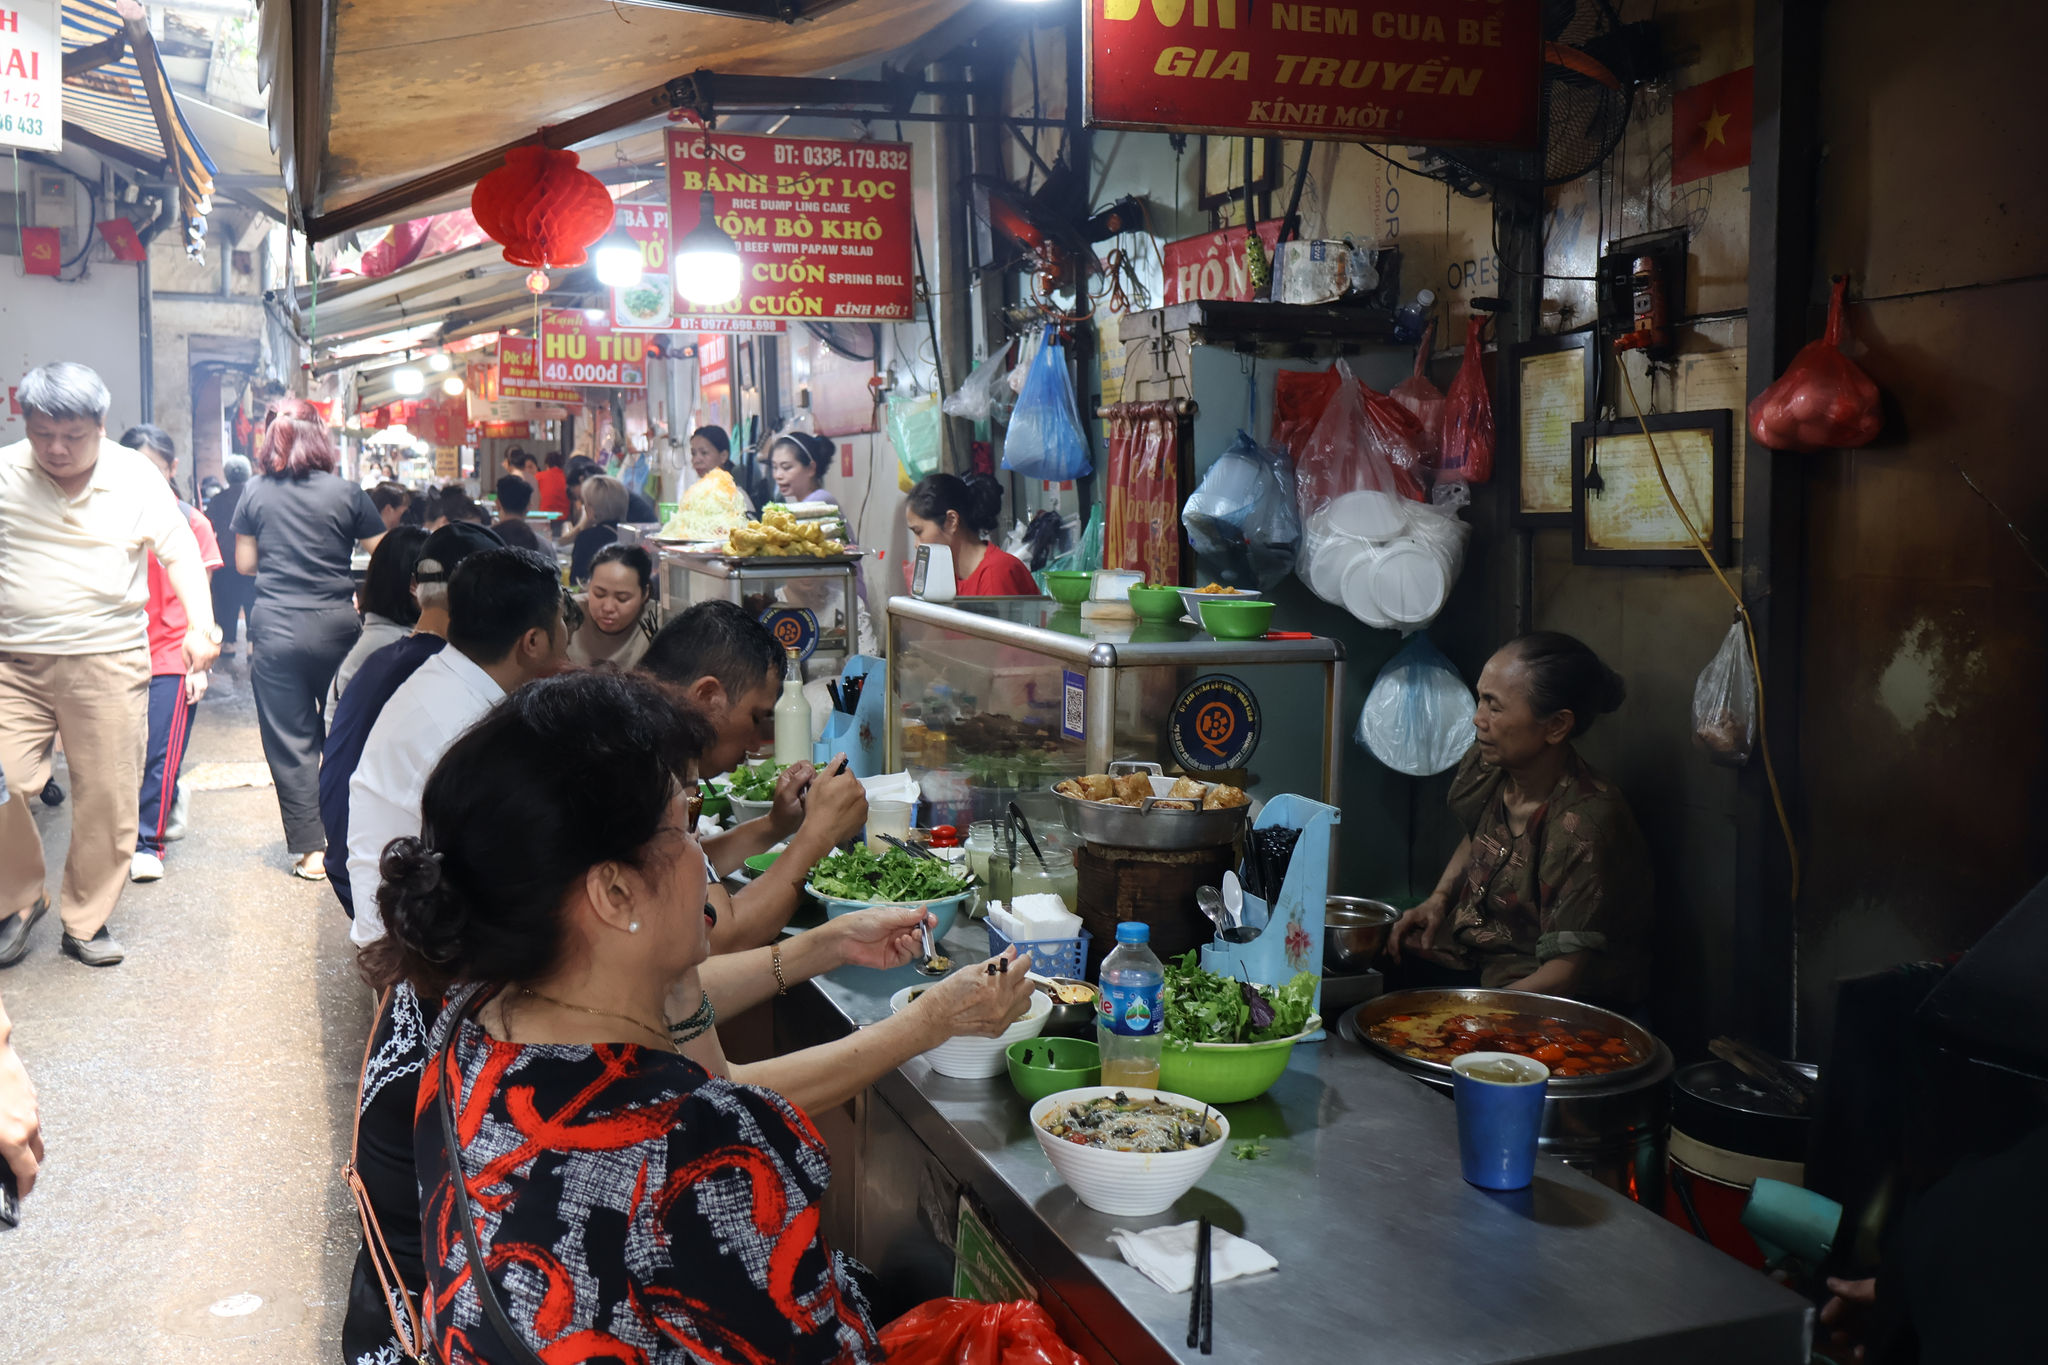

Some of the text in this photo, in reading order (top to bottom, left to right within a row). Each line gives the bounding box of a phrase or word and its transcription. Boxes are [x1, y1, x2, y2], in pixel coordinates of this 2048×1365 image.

[1272, 3, 1358, 36] NEM
[1372, 11, 1446, 43] CUA
[0, 48, 38, 80] AI
[1153, 46, 1484, 96] GIA TRUYỀN
[17, 116, 43, 136] 433
[1247, 97, 1328, 125] KÍNH
[1332, 102, 1390, 129] MỜI
[675, 137, 908, 171] HỒNG ĐT: 0336.179.832
[682, 167, 896, 204] BÁNH BỘT LỌC
[653, 211, 668, 228] P
[732, 198, 851, 214] RICE DUMP LING CAKE
[775, 213, 813, 238] BÒ
[821, 215, 883, 241] KHÔ
[744, 242, 770, 253] BEEF
[772, 243, 799, 255] WITH
[801, 244, 838, 256] PAPAW
[841, 245, 874, 257] SALAD
[752, 256, 826, 284] CUỐN
[828, 272, 873, 286] SPRING
[875, 274, 904, 287] ROLL
[1177, 235, 1262, 303] HỒN
[749, 289, 823, 315] CUỐN
[834, 302, 872, 316] KÍNH
[546, 327, 587, 360] HỦ
[546, 363, 618, 383] 40.000đ
